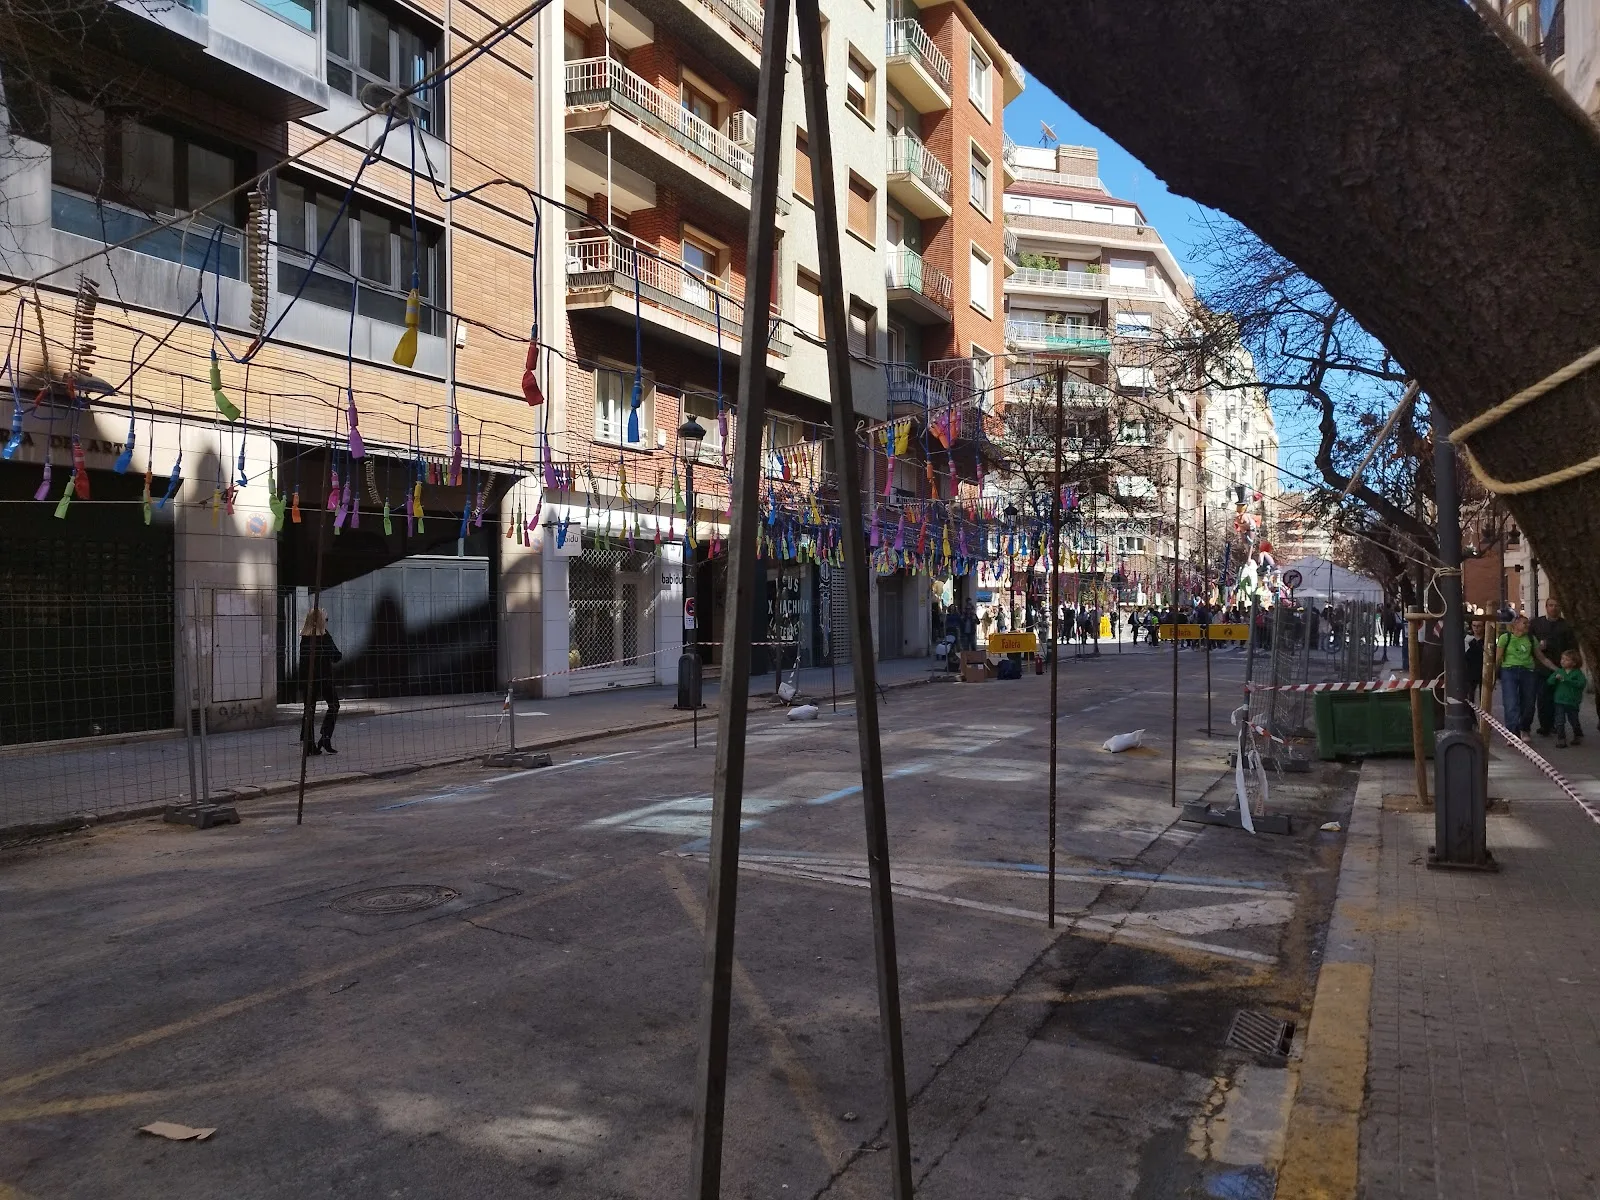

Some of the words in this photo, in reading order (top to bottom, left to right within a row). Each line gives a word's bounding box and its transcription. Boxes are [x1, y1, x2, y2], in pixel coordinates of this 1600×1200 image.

[88, 440, 128, 456] ART
[555, 534, 579, 543] bbidu
[661, 572, 684, 585] babidu
[1169, 627, 1192, 637] Flera
[1001, 638, 1021, 649] Fallera
